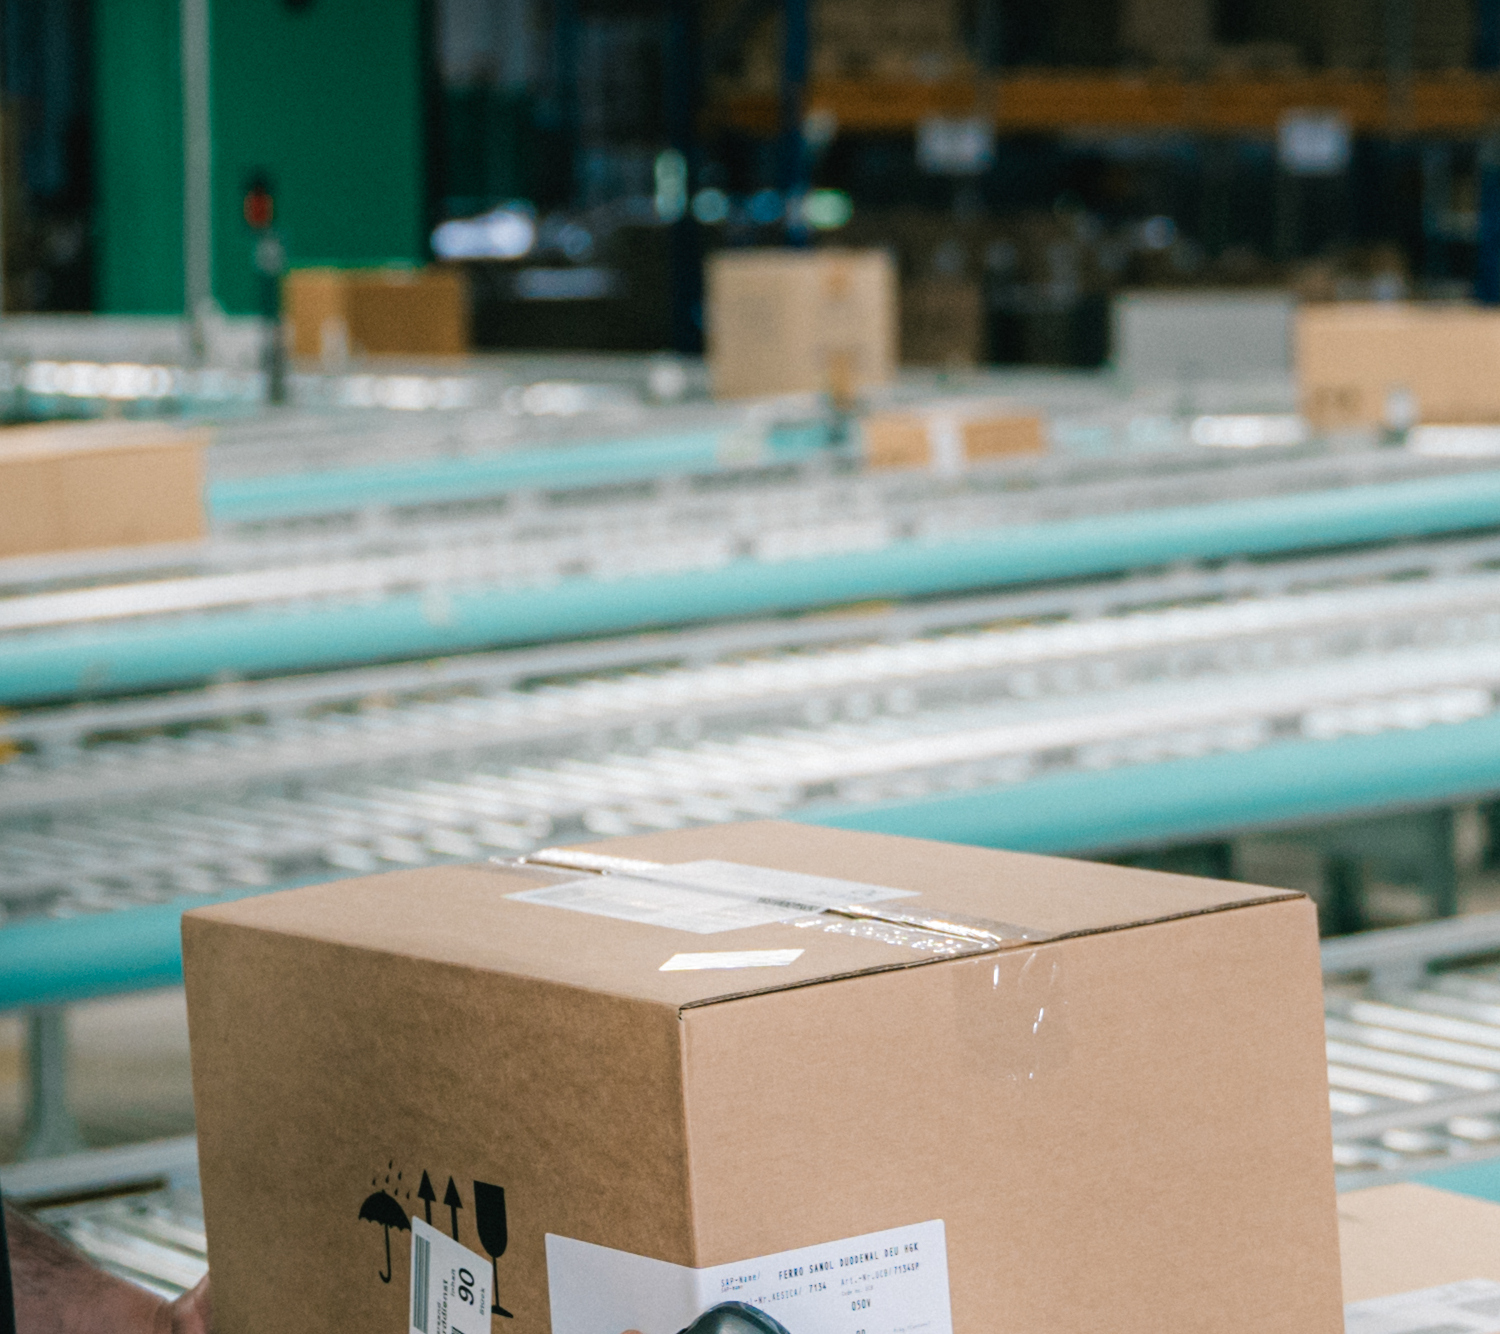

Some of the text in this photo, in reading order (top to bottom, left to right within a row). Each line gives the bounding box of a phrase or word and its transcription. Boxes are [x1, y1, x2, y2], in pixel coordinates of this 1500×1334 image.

[779, 1267, 803, 1280] FERRO
[809, 1261, 834, 1273] SANOL
[840, 1251, 879, 1267] DUODENAL
[884, 1246, 898, 1257] DEU
[458, 1268, 474, 1306] 90
[809, 1282, 827, 1293] 7134
